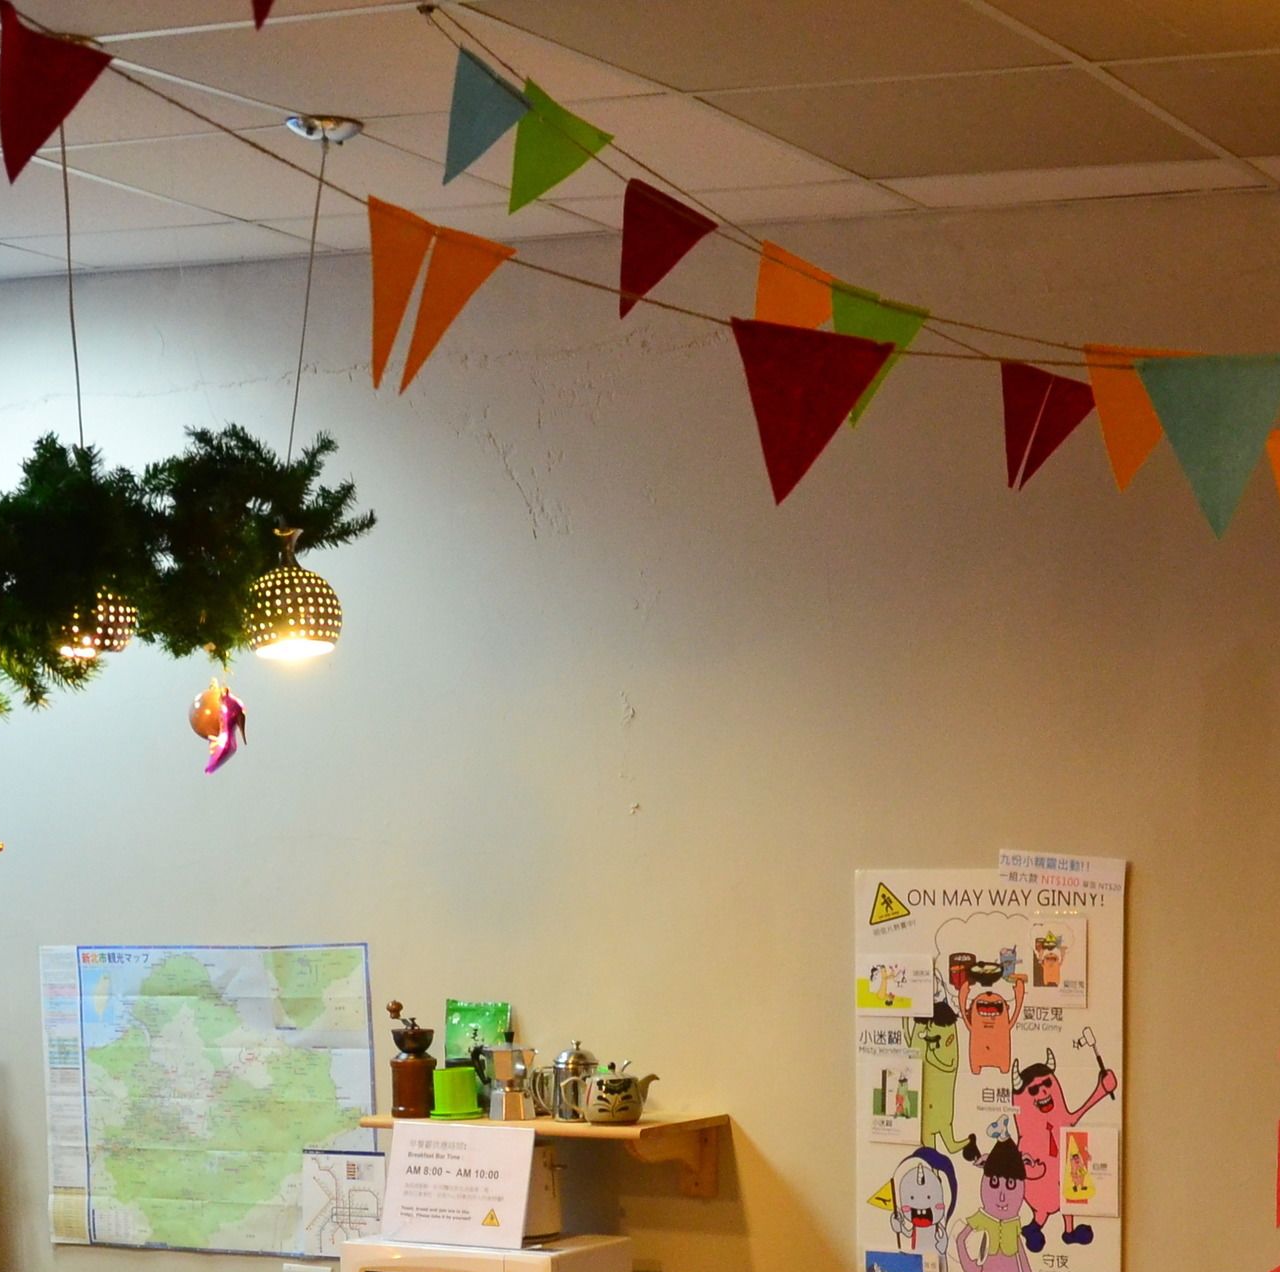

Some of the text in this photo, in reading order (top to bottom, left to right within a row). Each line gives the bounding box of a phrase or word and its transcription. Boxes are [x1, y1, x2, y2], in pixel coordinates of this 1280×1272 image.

[1041, 874, 1080, 887] NT$100
[907, 889, 1105, 907] ON MAY WAY GINNY!
[406, 1166, 421, 1176] AM
[423, 1167, 443, 1176] 8:00
[456, 1168, 472, 1178] AM
[475, 1169, 500, 1180] 10:00
[1042, 1254, 1069, 1269] 守夜
